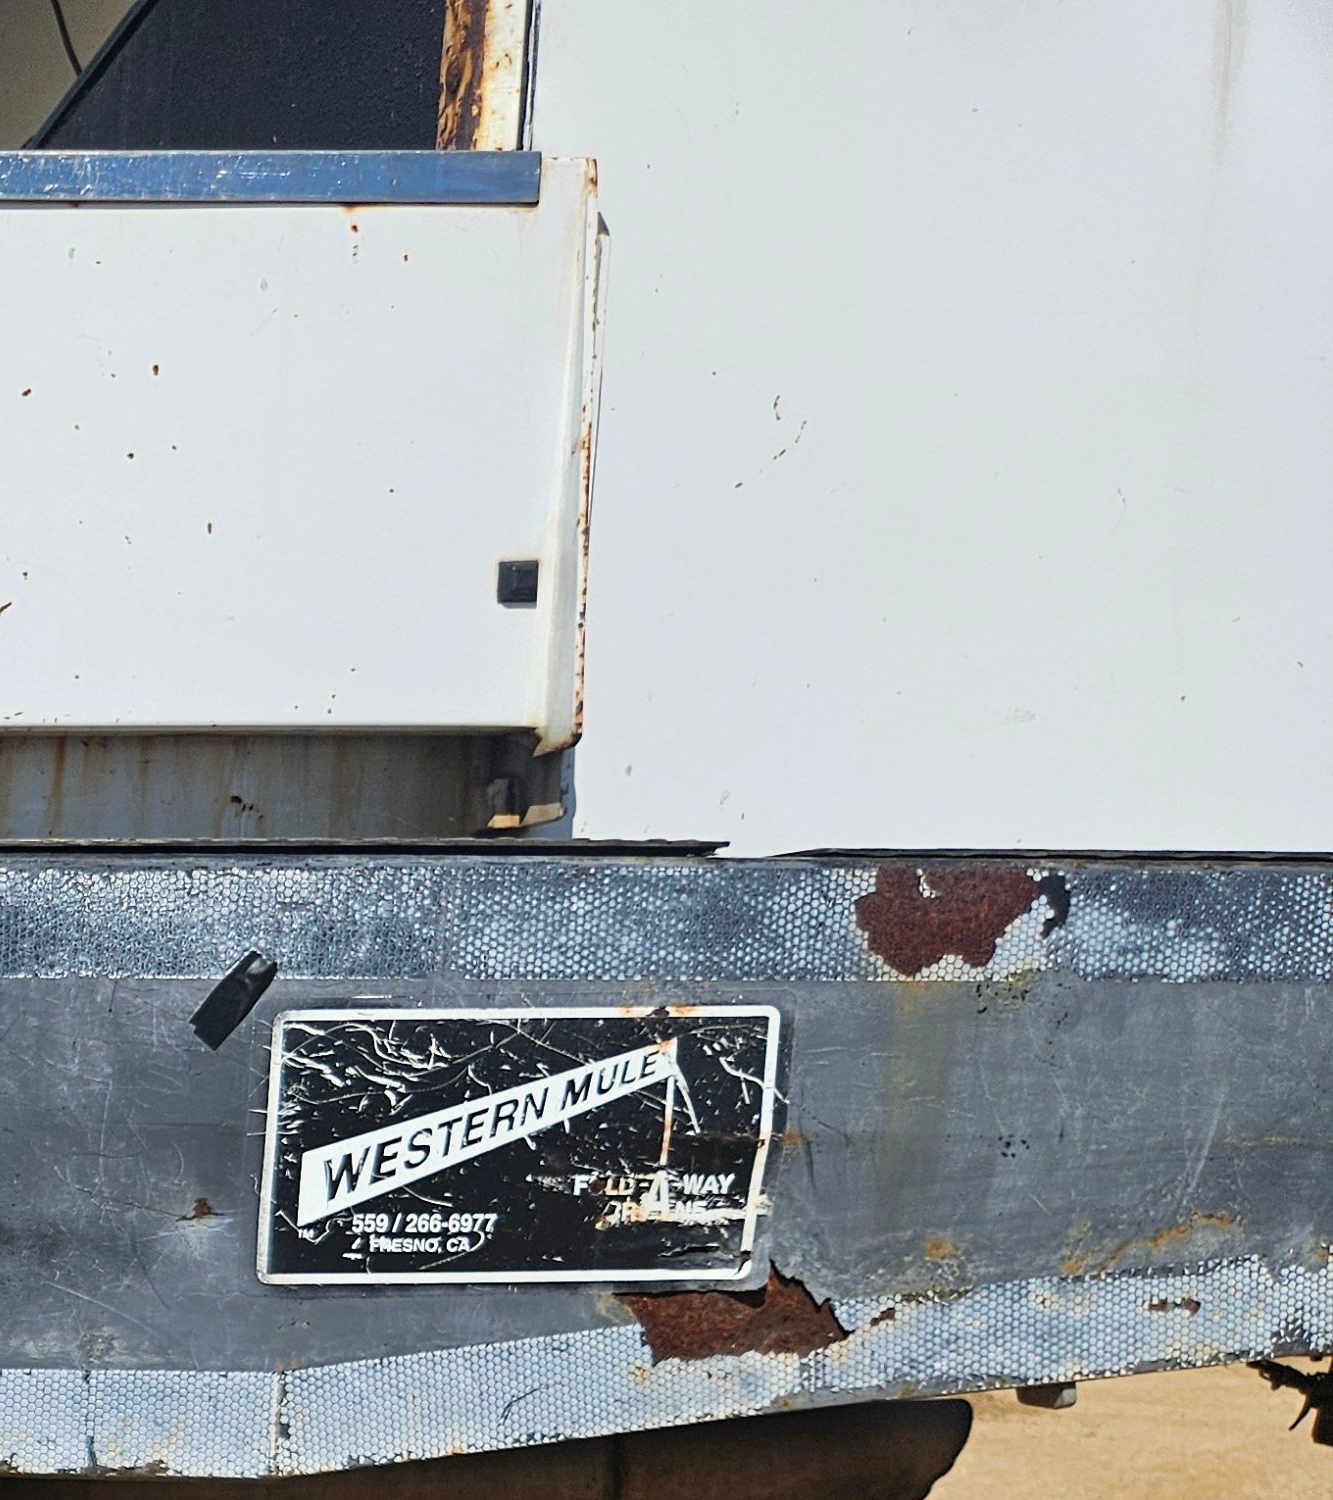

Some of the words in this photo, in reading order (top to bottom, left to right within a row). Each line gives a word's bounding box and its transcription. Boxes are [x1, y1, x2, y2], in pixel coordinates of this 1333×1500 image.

[324, 1087, 550, 1200] WESTERN
[559, 1049, 659, 1111] MULE
[351, 1213, 389, 1233] 559
[404, 1213, 498, 1233] 266-6977
[446, 1236, 471, 1252] CA
